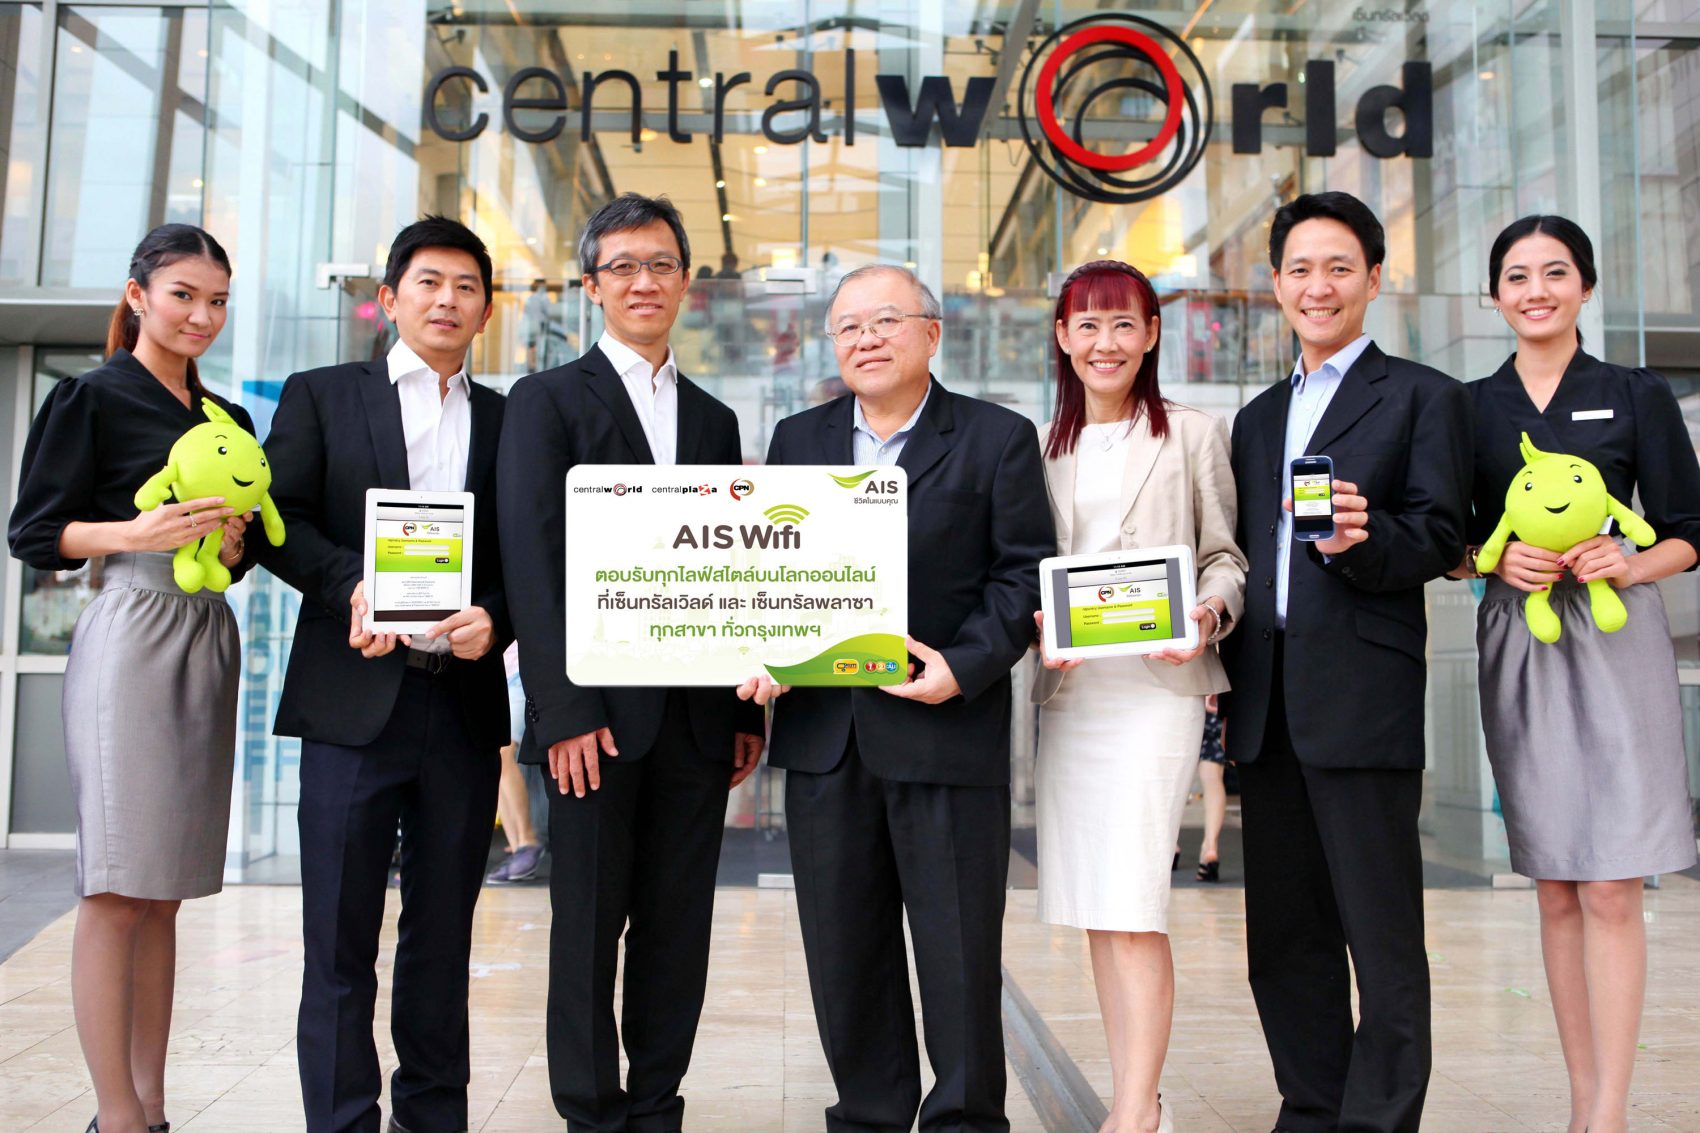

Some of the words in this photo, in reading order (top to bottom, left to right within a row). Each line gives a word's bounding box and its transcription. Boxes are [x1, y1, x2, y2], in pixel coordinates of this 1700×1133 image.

[573, 483, 643, 496] centralworld
[651, 483, 718, 496] centralplaza
[733, 484, 750, 492] CPN
[864, 480, 899, 494] AIS
[853, 496, 899, 506] ชีวิตในแบบคุณ
[672, 524, 734, 550] AIS
[739, 524, 801, 550] Wifi
[595, 565, 877, 588] ตอบรับทุกไลฟ์สไตล์บนโลกออนไลน์
[597, 588, 714, 610] ที่เซ็นทรัลเวิลด์
[718, 595, 747, 610] และ
[751, 591, 875, 610] เซ็นทรัลพลาซา
[649, 622, 717, 643] ทุกสาขา
[721, 616, 822, 643] ทั่วกรุงเทพฯ
